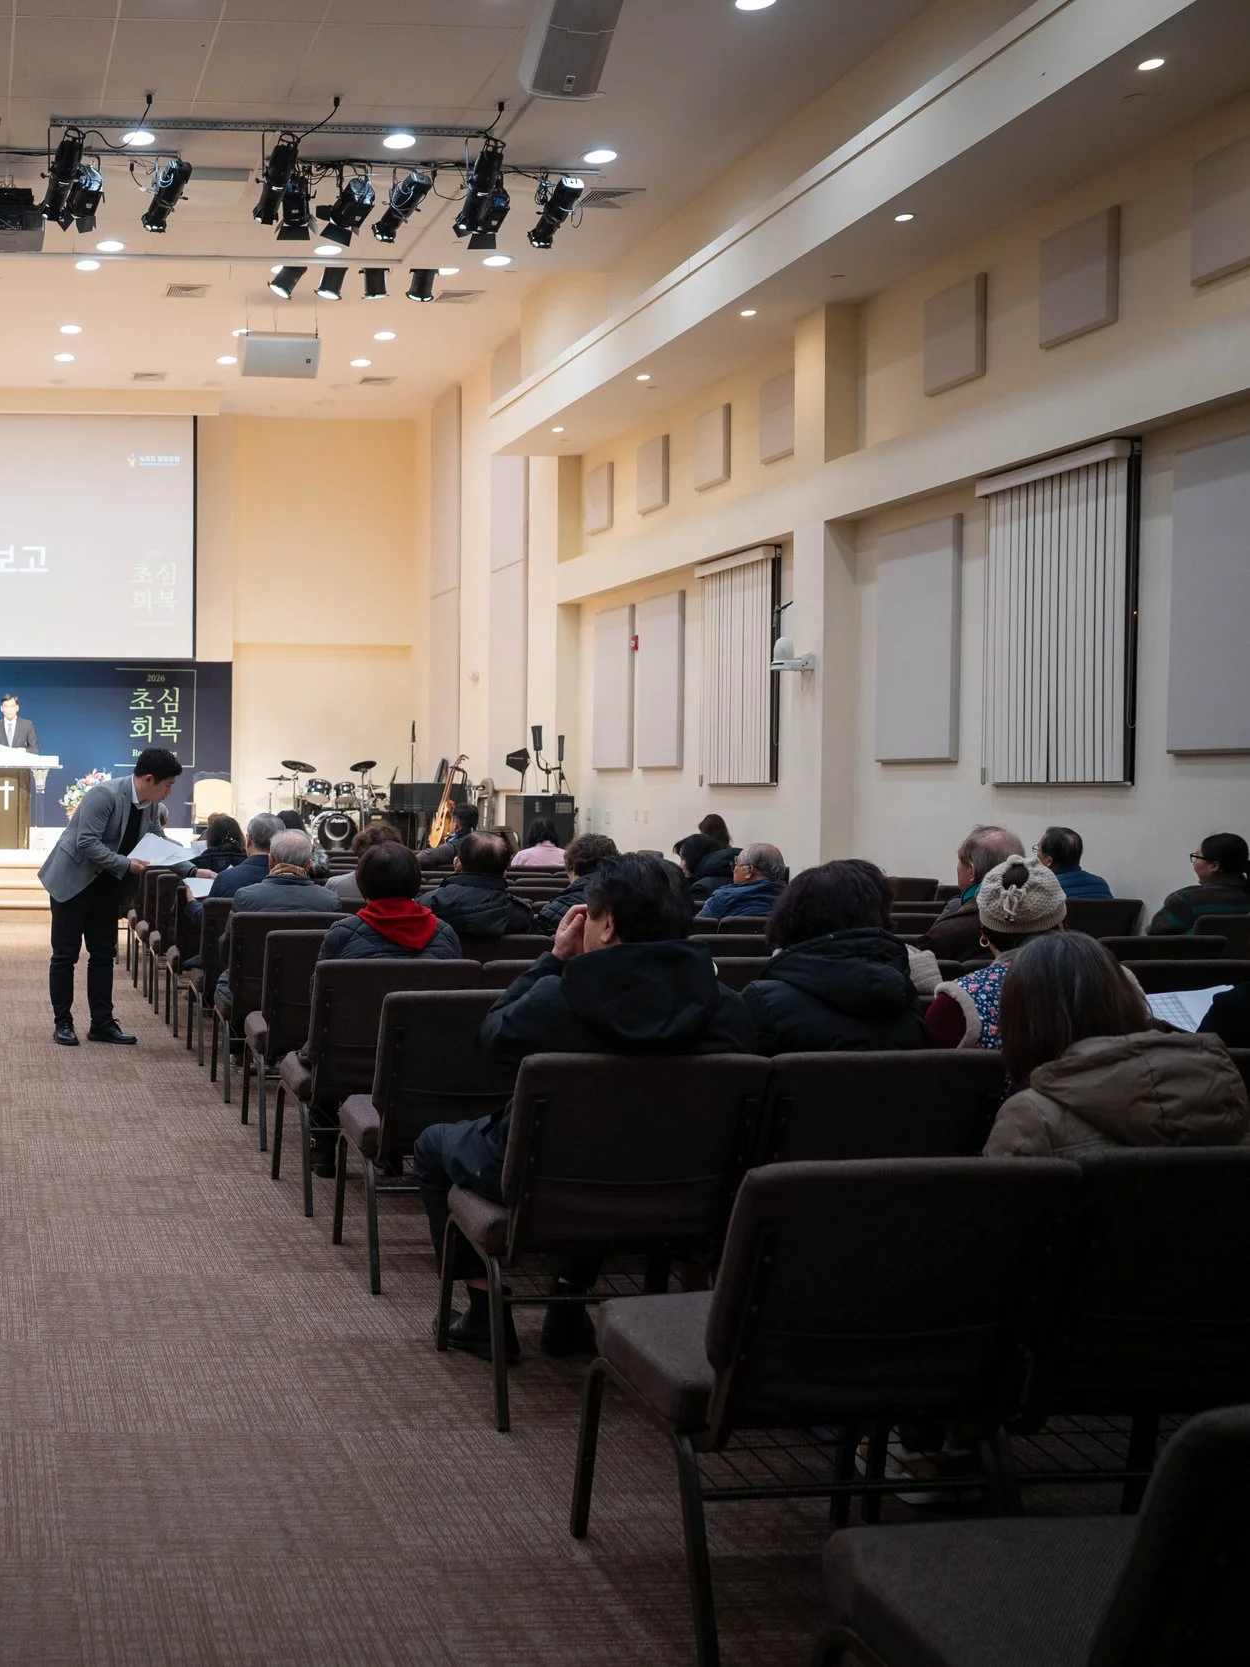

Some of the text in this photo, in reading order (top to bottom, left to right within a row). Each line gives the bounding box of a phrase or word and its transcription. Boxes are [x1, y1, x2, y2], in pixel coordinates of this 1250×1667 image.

[130, 562, 177, 586] 초심
[130, 588, 179, 613] 회복
[146, 674, 166, 682] 2026
[129, 687, 180, 714] 초심
[129, 715, 182, 743] 회복
